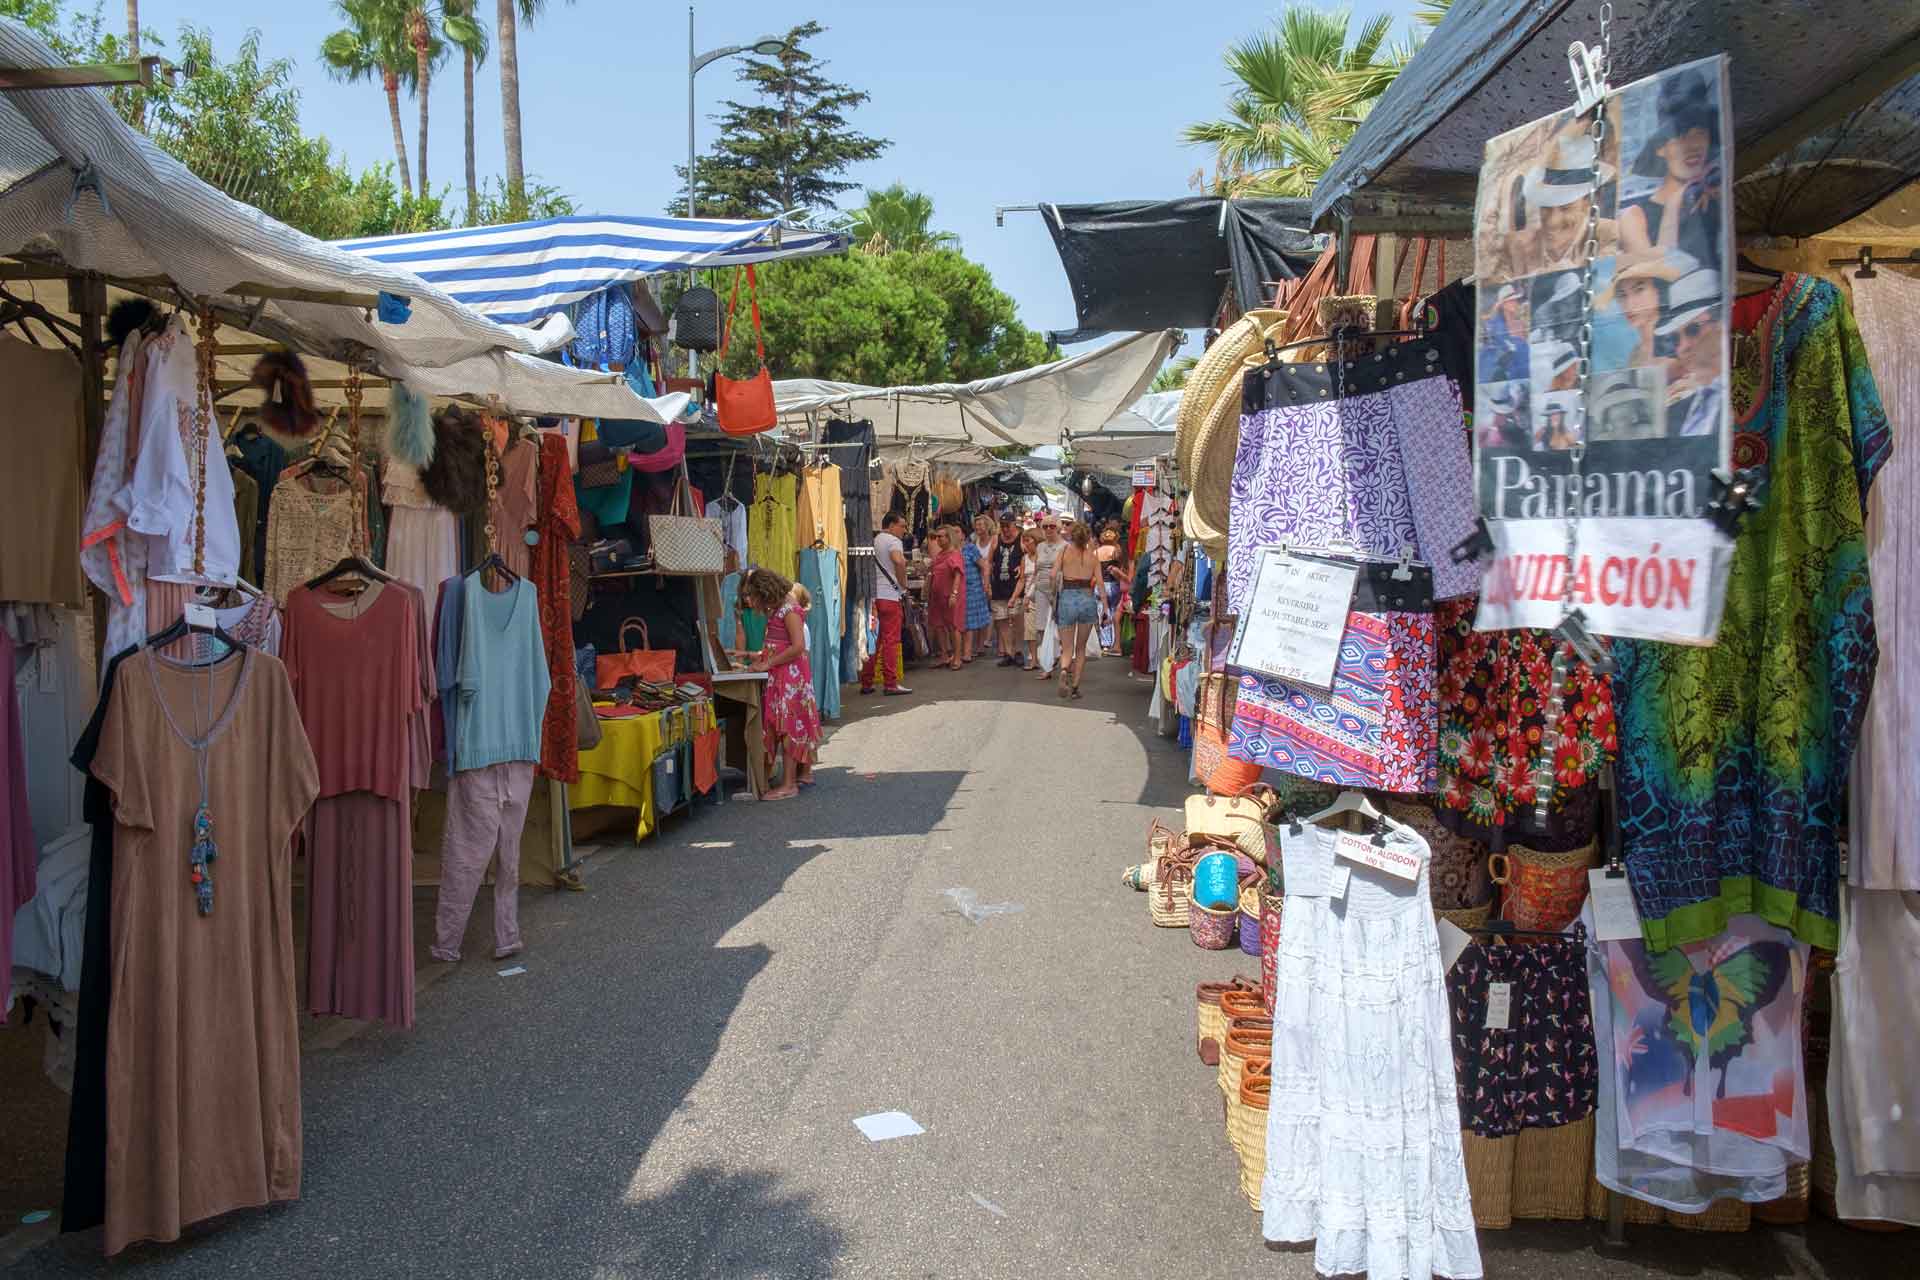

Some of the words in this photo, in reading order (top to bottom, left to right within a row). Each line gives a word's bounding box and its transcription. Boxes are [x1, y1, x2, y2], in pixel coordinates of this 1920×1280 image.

[1490, 456, 1702, 519] Panama
[1343, 836, 1374, 854] COTTON
[1378, 849, 1417, 868] ALGODON
